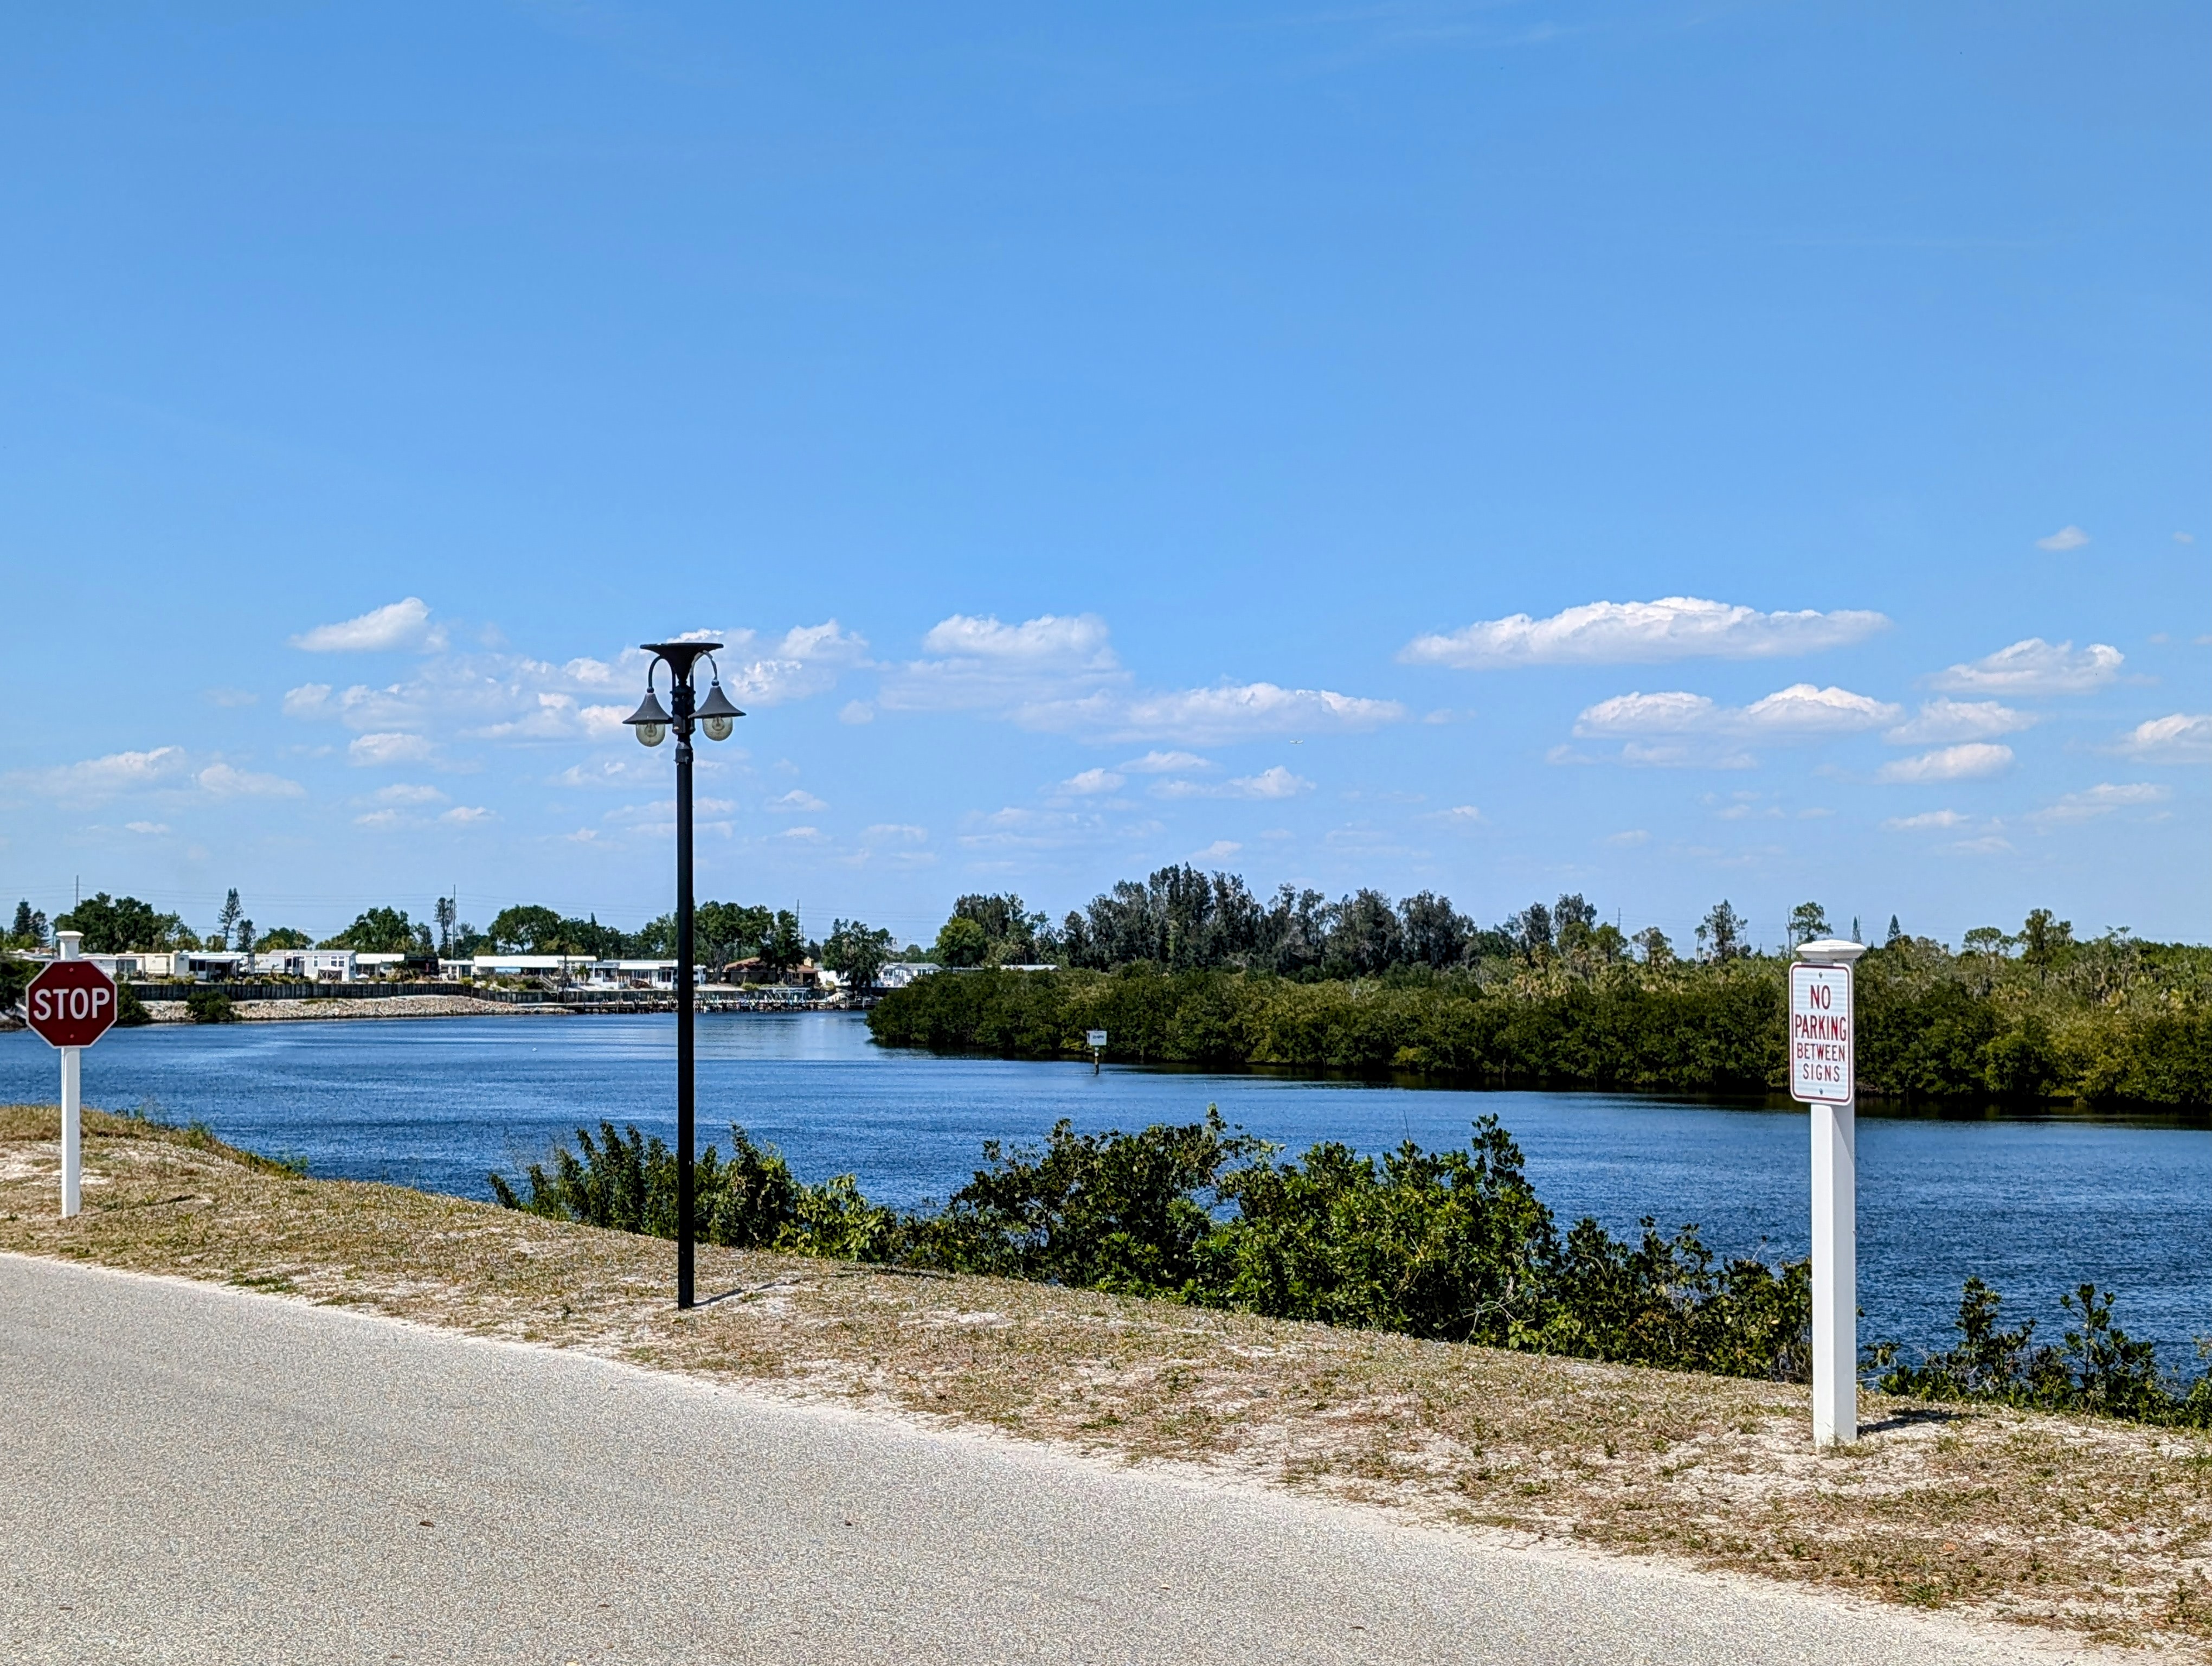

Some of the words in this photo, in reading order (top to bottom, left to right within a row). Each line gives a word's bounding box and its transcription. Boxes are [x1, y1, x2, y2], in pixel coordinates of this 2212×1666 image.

[33, 988, 110, 1021] STOP
[1810, 985, 1831, 1010] NO
[1795, 1014, 1847, 1041] PARKING
[1797, 1042, 1845, 1062] BETWEEN
[1803, 1063, 1840, 1082] SIGNS
